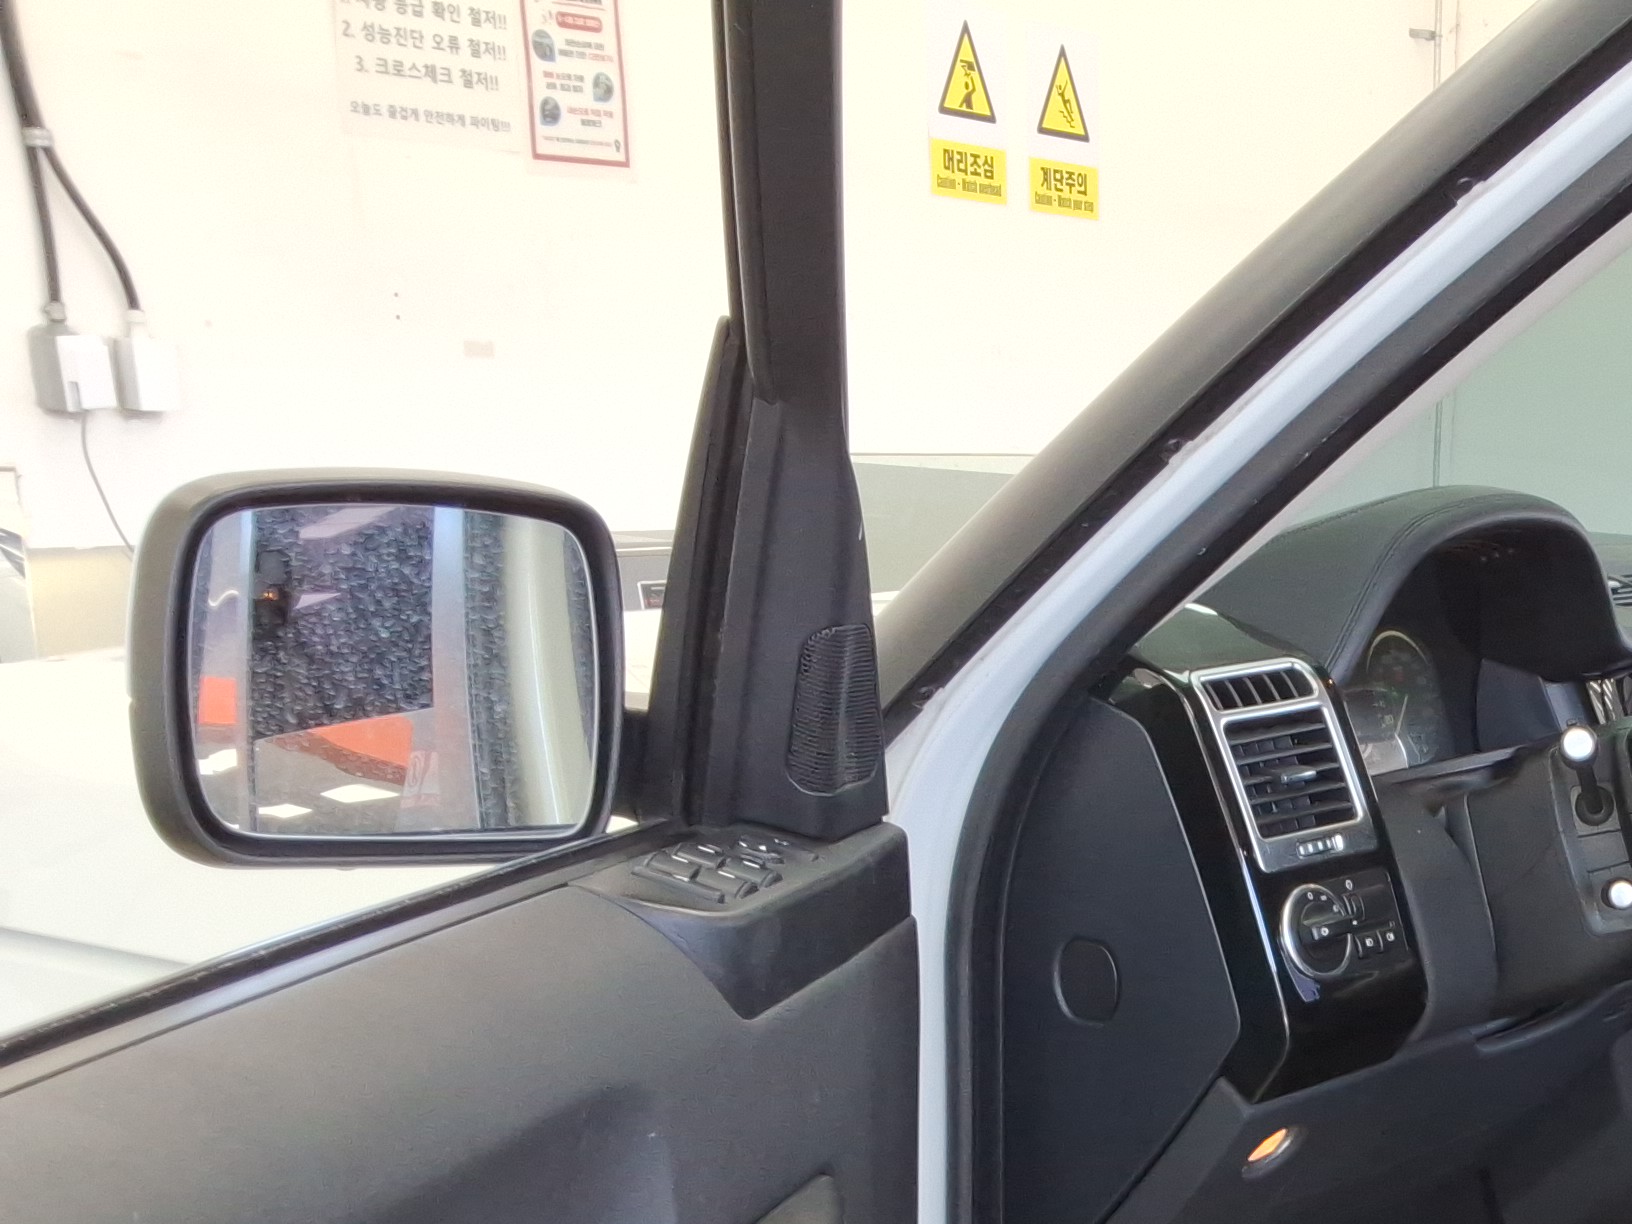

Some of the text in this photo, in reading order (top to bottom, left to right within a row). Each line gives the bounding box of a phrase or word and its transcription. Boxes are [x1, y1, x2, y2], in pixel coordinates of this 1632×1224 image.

[431, 1, 461, 24] 확인
[342, 20, 355, 39] 2.
[361, 21, 424, 50] 성능진단
[431, 33, 461, 56] 오류
[354, 55, 369, 73] 3.
[375, 56, 454, 84] 크로스체크
[350, 100, 383, 117] 오늘도
[943, 148, 995, 181] 머리조심
[1040, 166, 1088, 197] 계단주의
